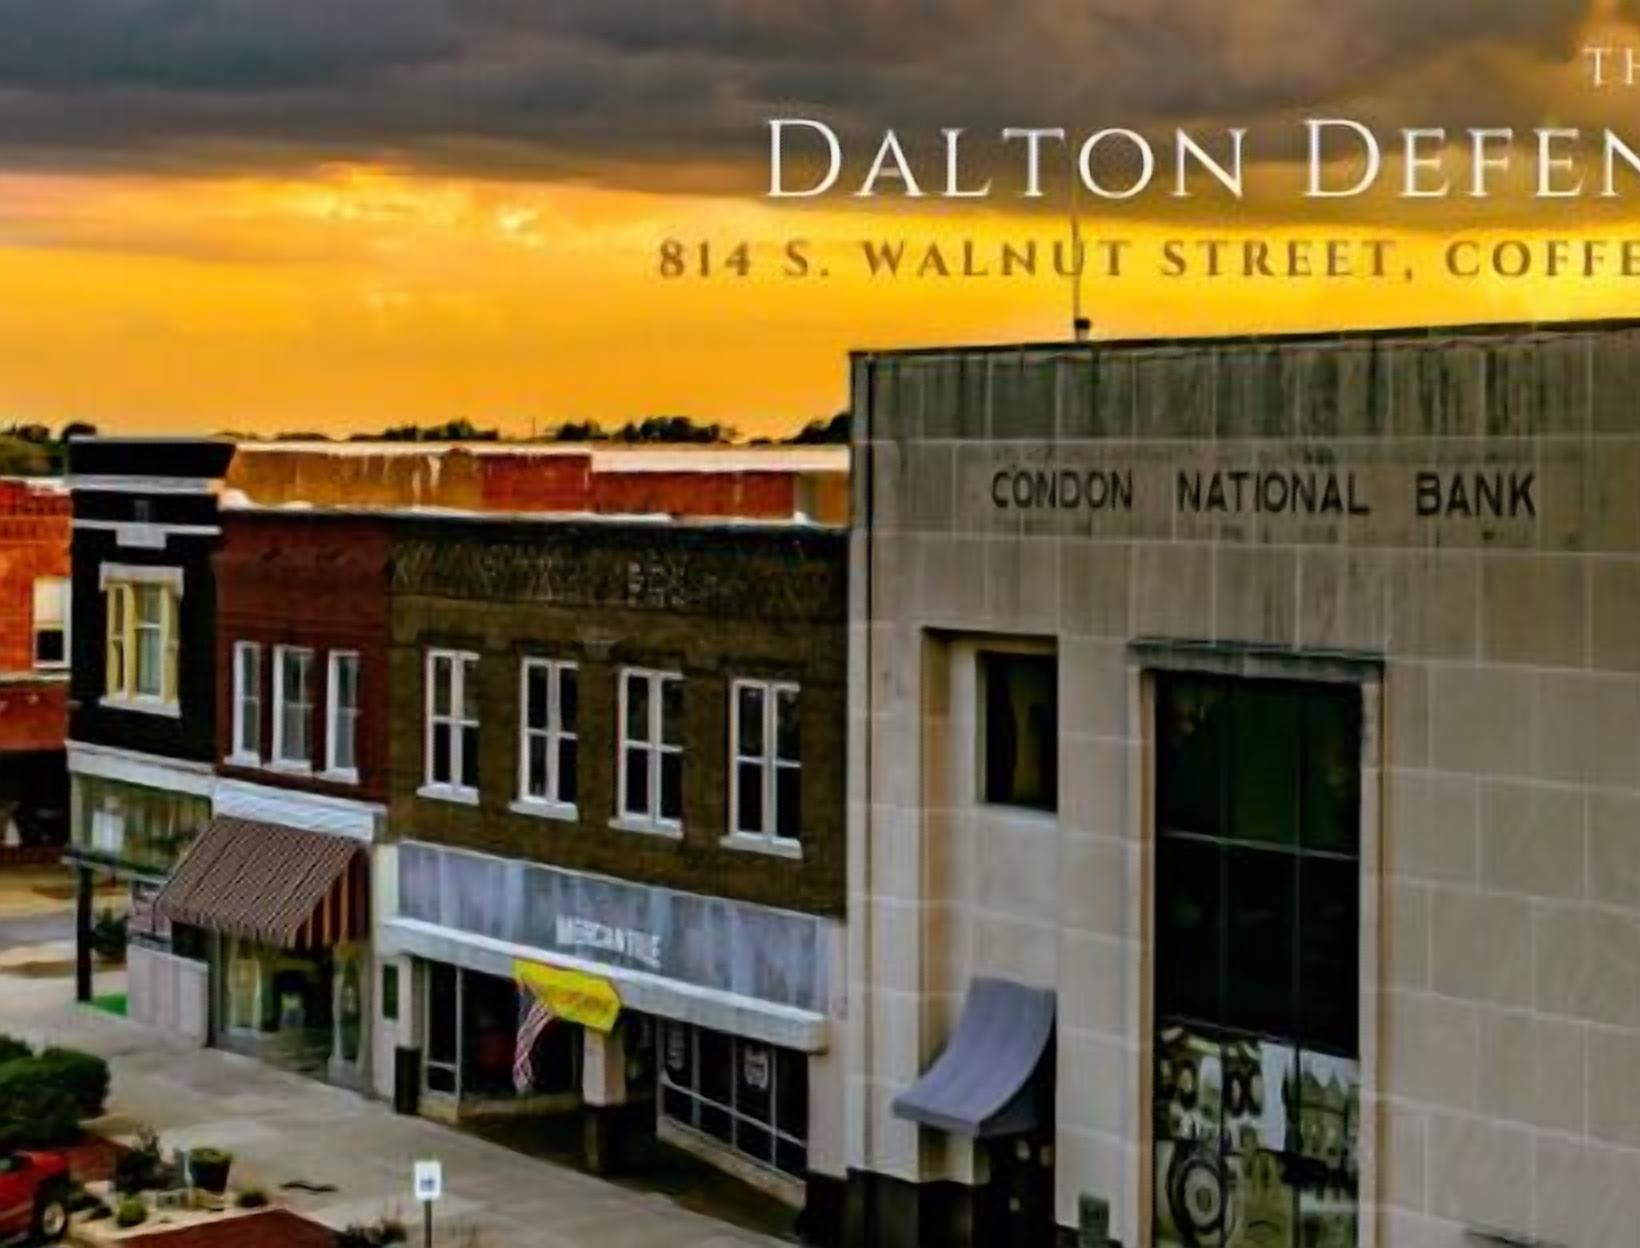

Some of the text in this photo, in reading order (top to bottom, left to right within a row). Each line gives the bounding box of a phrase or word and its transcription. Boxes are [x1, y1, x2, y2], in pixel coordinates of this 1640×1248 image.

[990, 469, 1537, 518] CONDON NATIONAL BANK
